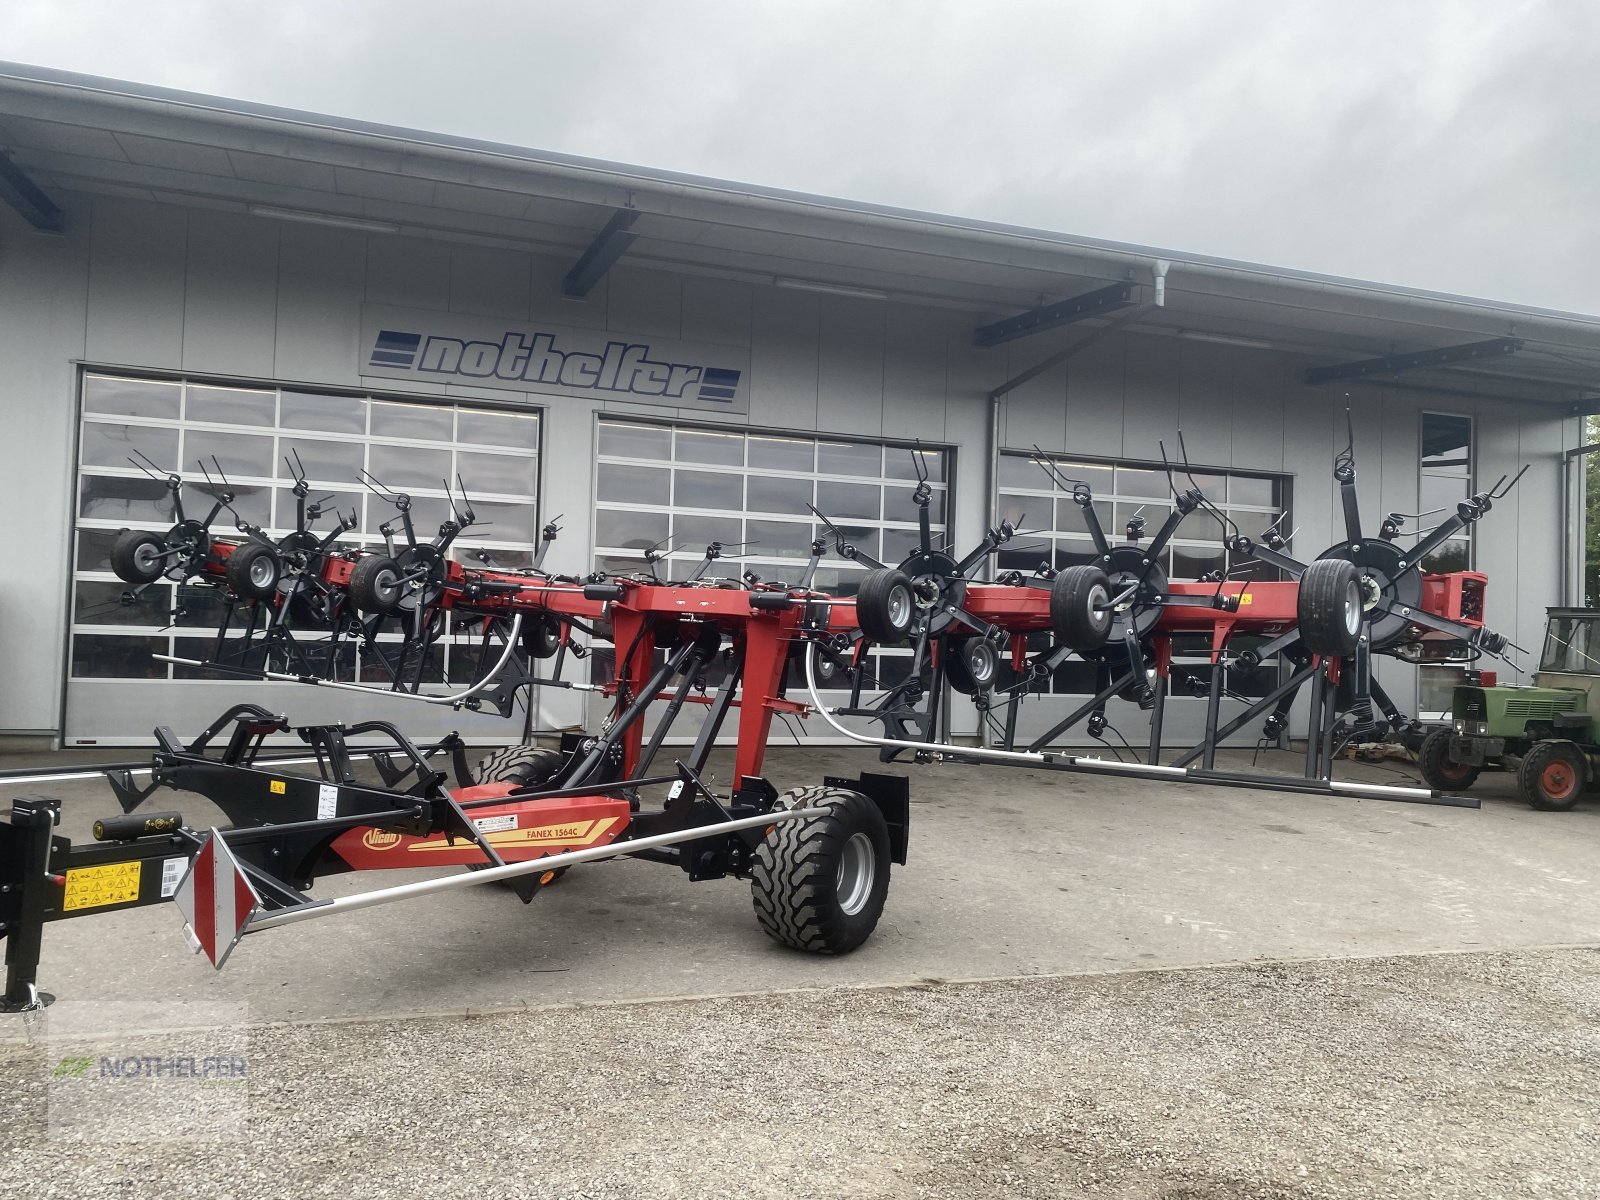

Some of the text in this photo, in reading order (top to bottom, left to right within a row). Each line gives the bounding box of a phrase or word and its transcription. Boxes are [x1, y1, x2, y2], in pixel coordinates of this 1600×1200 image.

[417, 332, 702, 397] nothelfer
[367, 828, 397, 844] Vicon
[527, 828, 578, 838] FANEX 1564C
